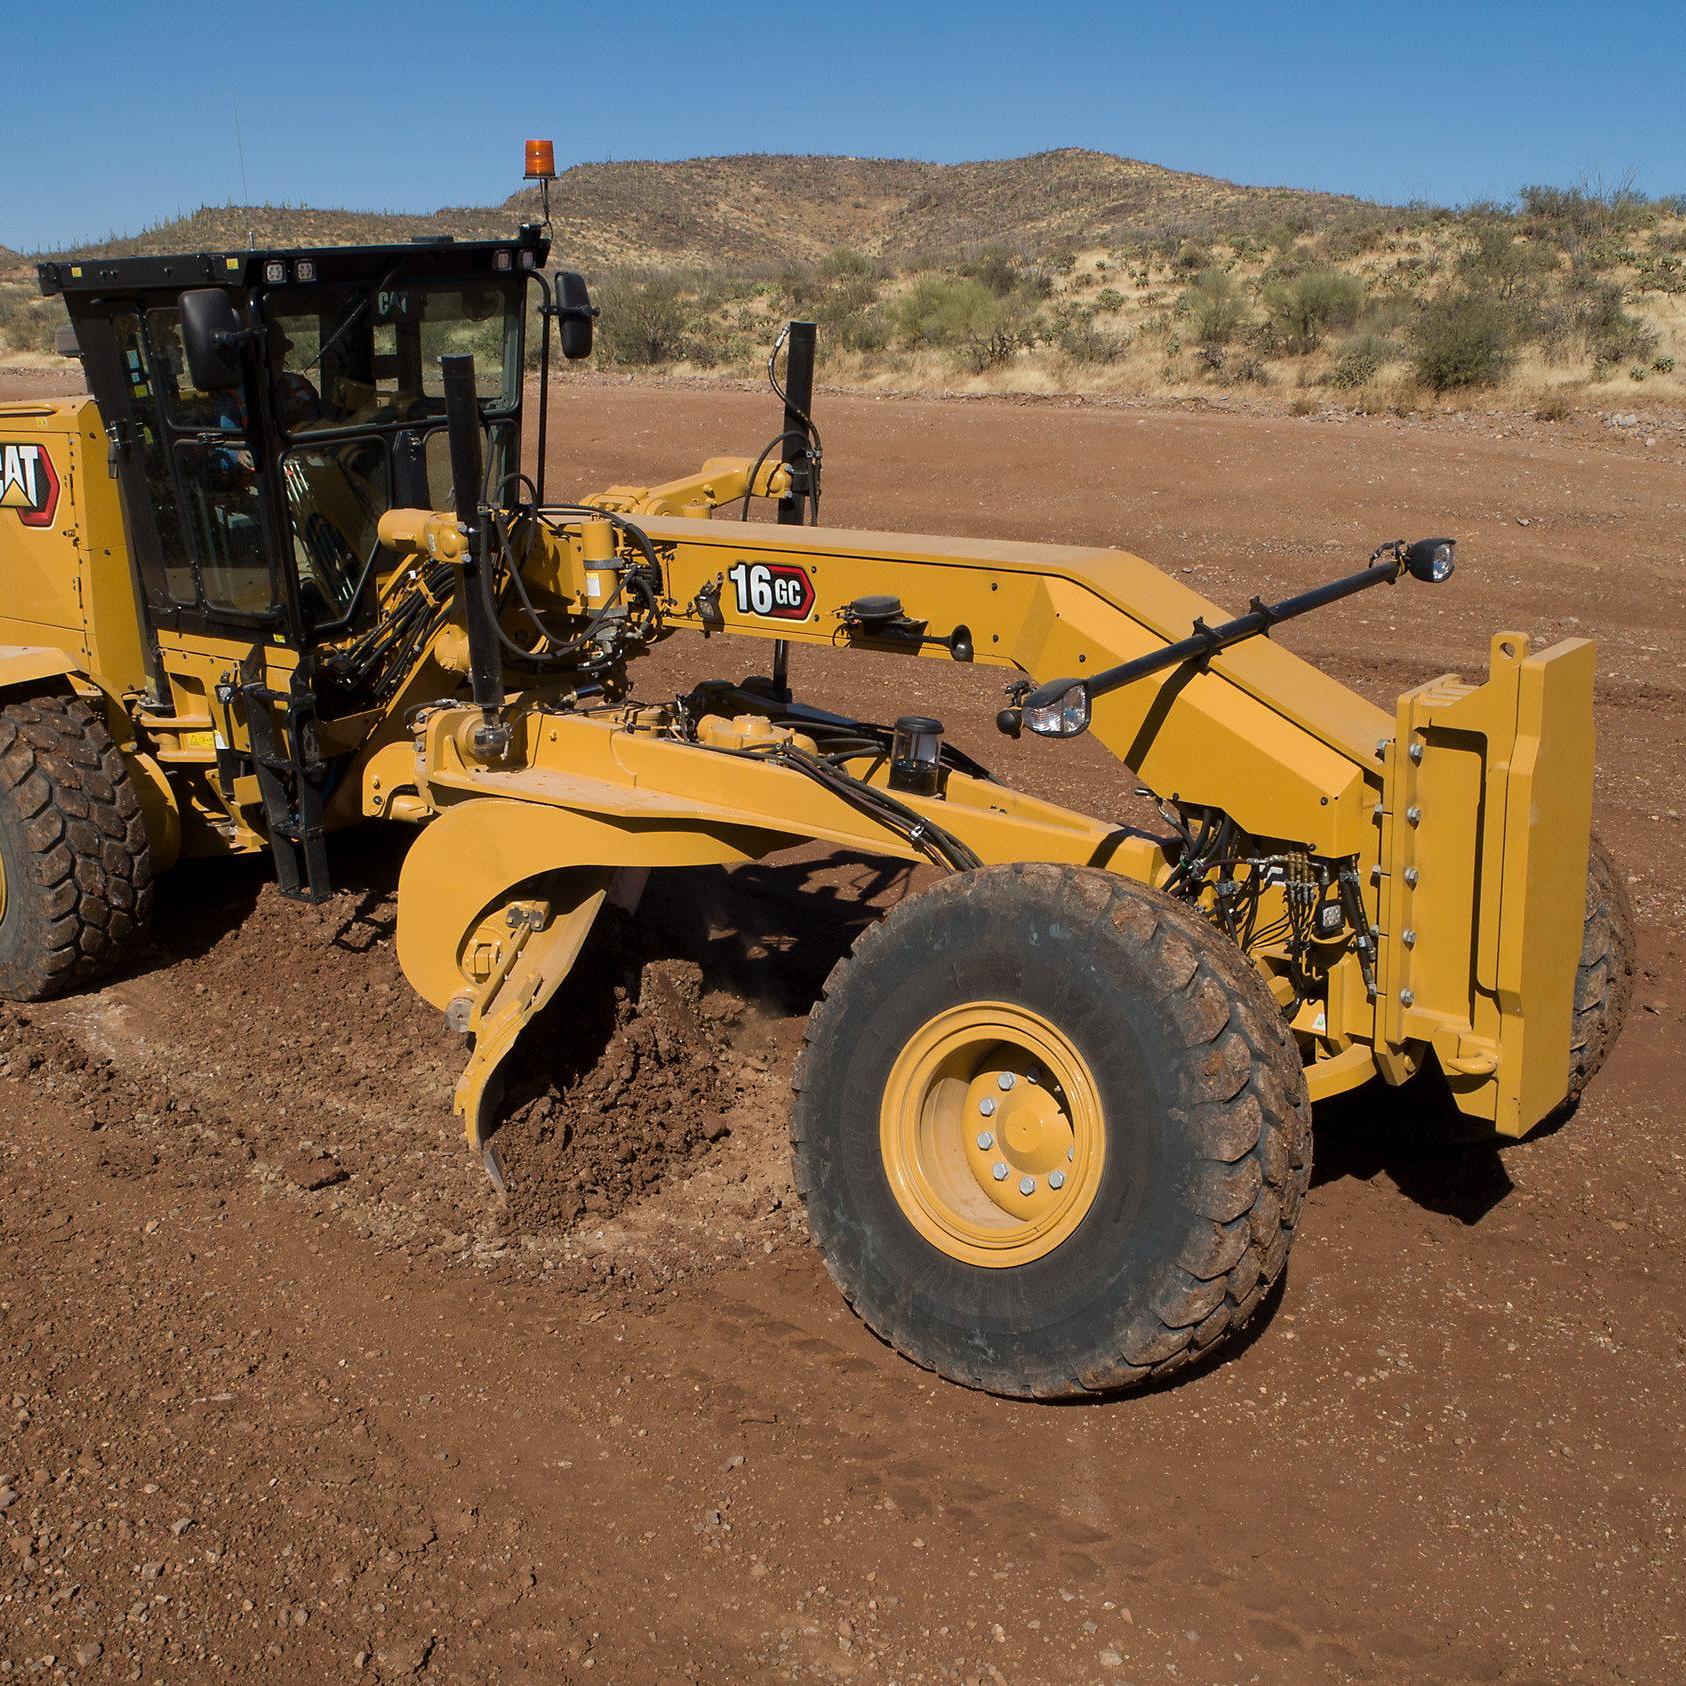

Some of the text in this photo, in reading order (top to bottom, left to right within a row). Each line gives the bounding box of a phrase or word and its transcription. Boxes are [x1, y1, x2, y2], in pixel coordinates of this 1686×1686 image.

[379, 291, 408, 315] CAT
[0, 445, 39, 507] AT
[730, 564, 801, 614] 16 GC
